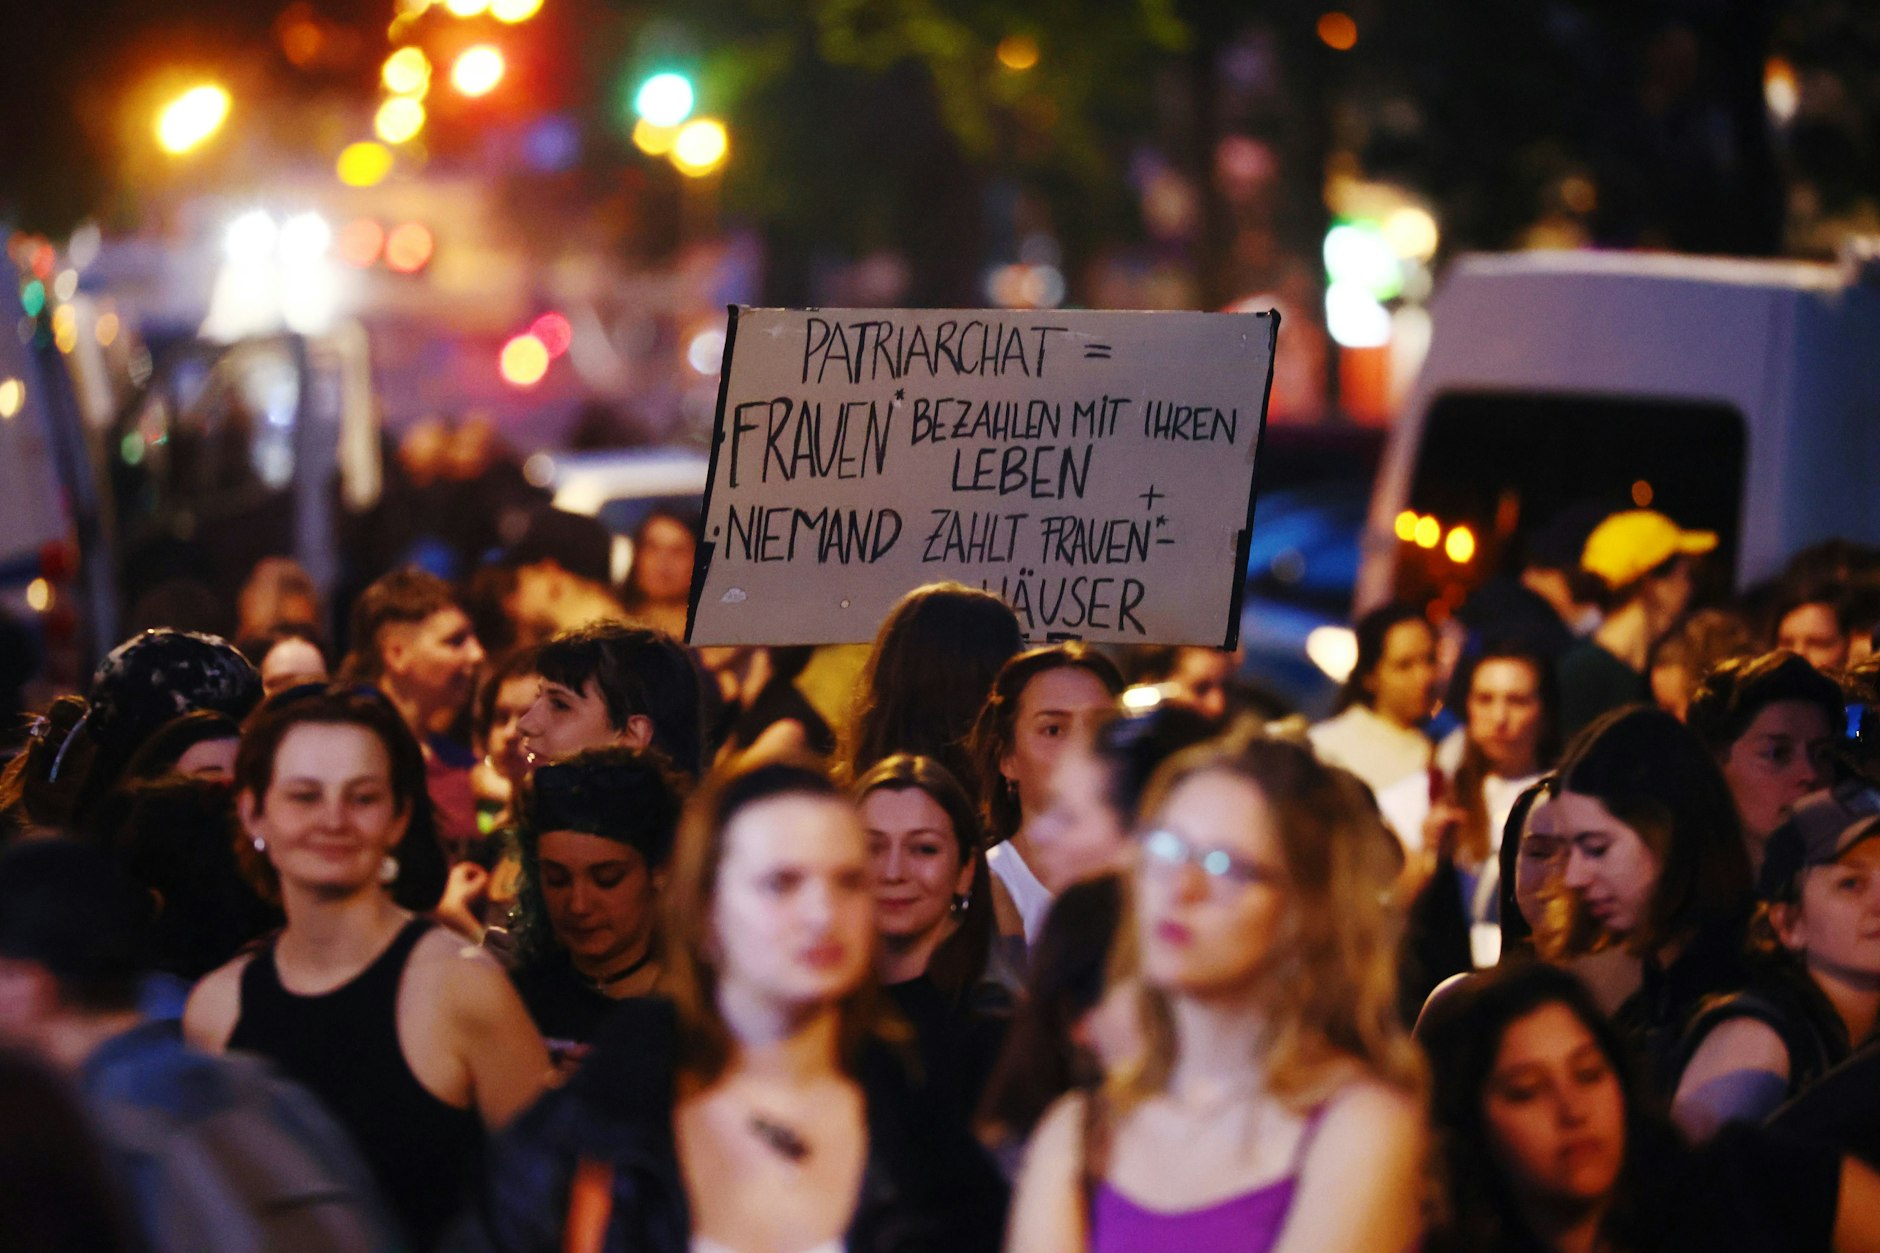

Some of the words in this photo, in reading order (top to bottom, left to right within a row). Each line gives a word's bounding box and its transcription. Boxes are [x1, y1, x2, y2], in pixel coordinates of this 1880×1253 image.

[801, 317, 1069, 385] PATRIARCHAT
[911, 398, 1061, 446] BEZAHLEN
[1143, 400, 1238, 445] IHREN
[951, 443, 1094, 500] LEBEN
[724, 503, 903, 564] NIEMAND
[921, 508, 1029, 564] ZAHLT
